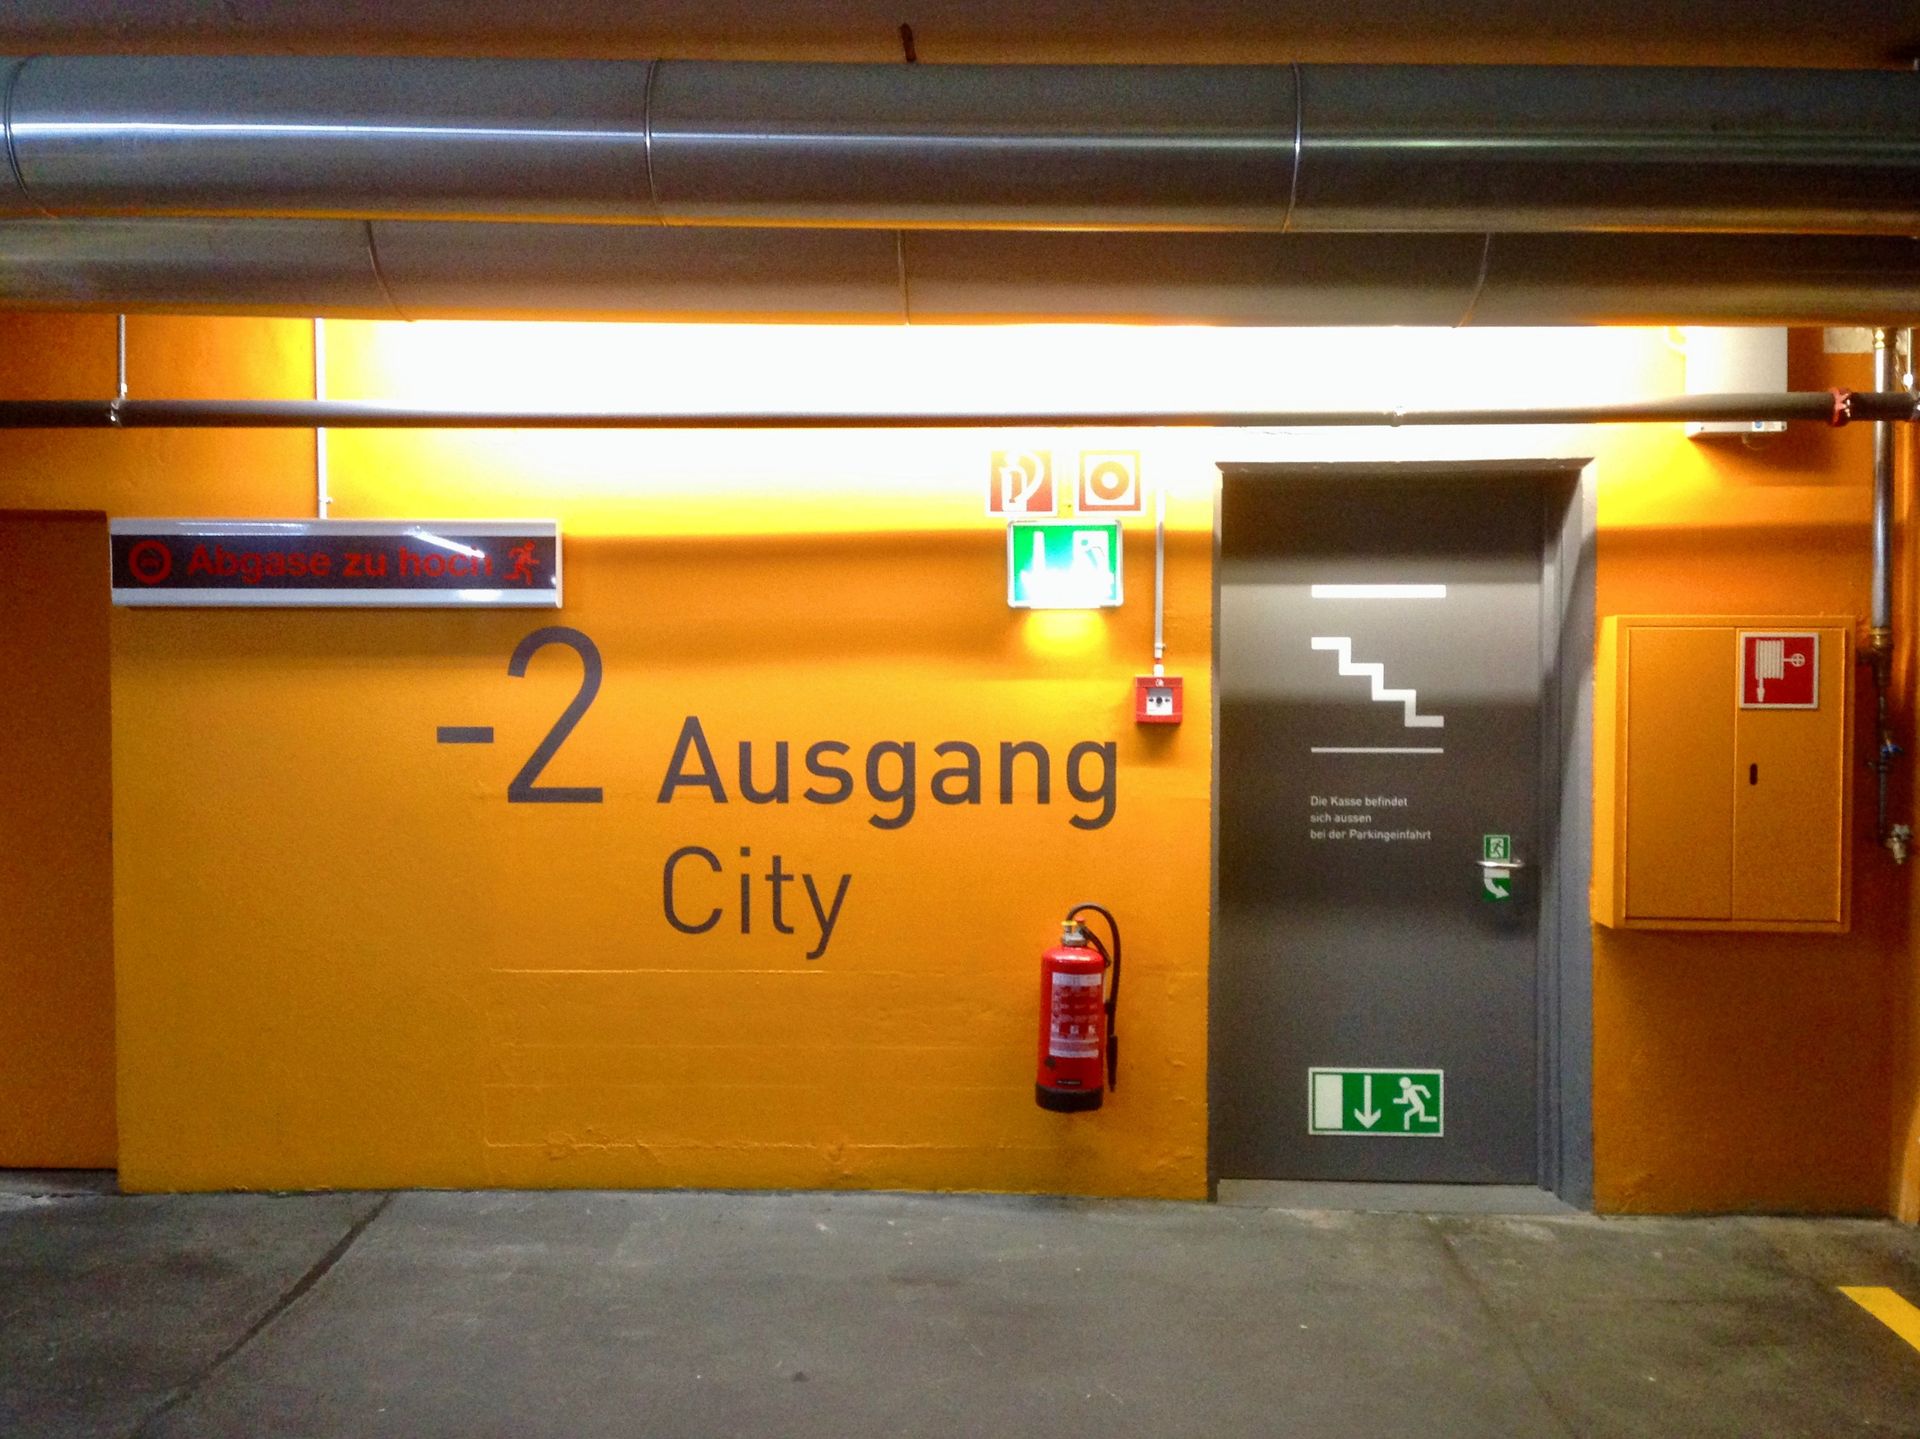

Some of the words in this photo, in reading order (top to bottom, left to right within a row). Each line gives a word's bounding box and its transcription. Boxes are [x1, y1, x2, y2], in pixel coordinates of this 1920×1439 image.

[187, 544, 331, 583] Abgase
[342, 552, 388, 576] zu
[400, 546, 492, 577] hoch
[437, 625, 604, 804] -2
[656, 715, 1118, 831] Ausgang
[1310, 796, 1328, 807] Die
[1330, 796, 1362, 807] Kasse
[1365, 796, 1408, 807] befindet
[1310, 813, 1332, 823] sich
[1334, 814, 1372, 823] aussen
[1310, 830, 1326, 839] bei
[1328, 830, 1347, 839] der
[1349, 830, 1431, 842] Parkingeinfahrt
[662, 846, 852, 960] City
